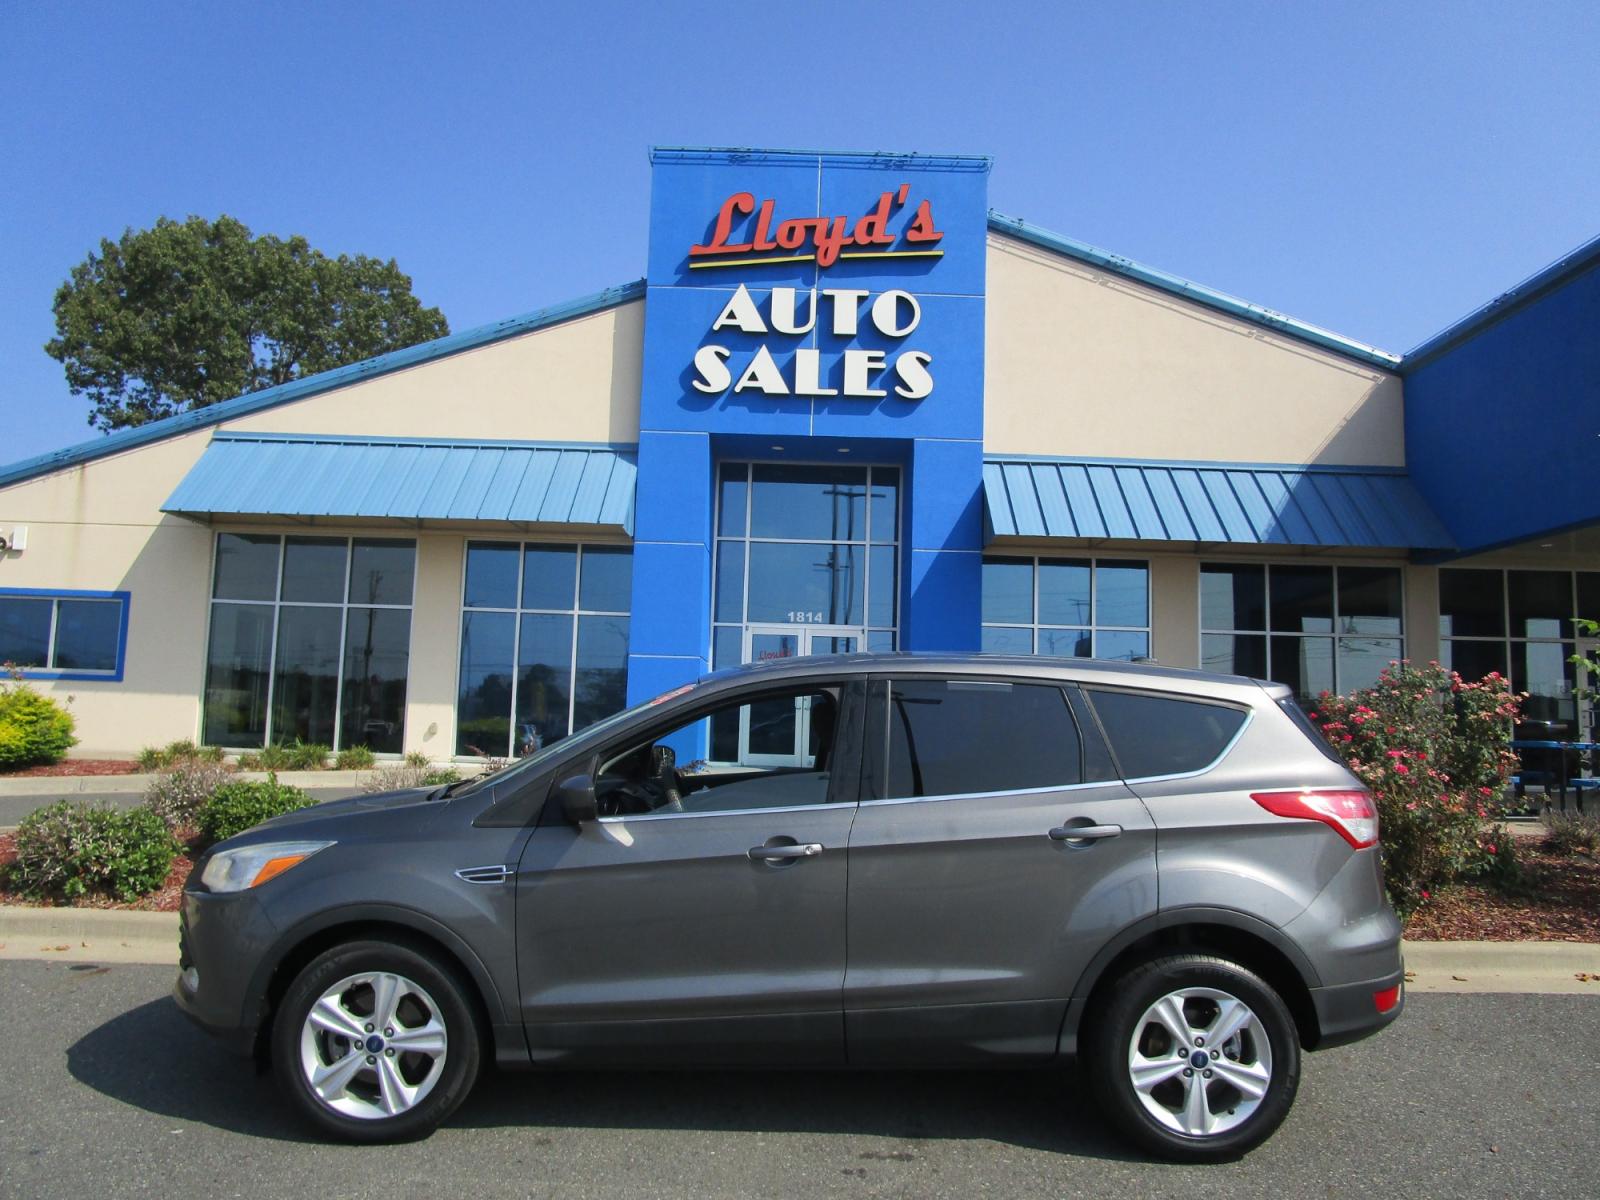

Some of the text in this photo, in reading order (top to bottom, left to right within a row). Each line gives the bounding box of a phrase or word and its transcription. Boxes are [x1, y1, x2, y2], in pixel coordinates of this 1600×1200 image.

[688, 183, 945, 267] Lloyd's
[712, 283, 921, 337] AUTO
[692, 344, 934, 399] SALES
[787, 611, 823, 623] 1814
